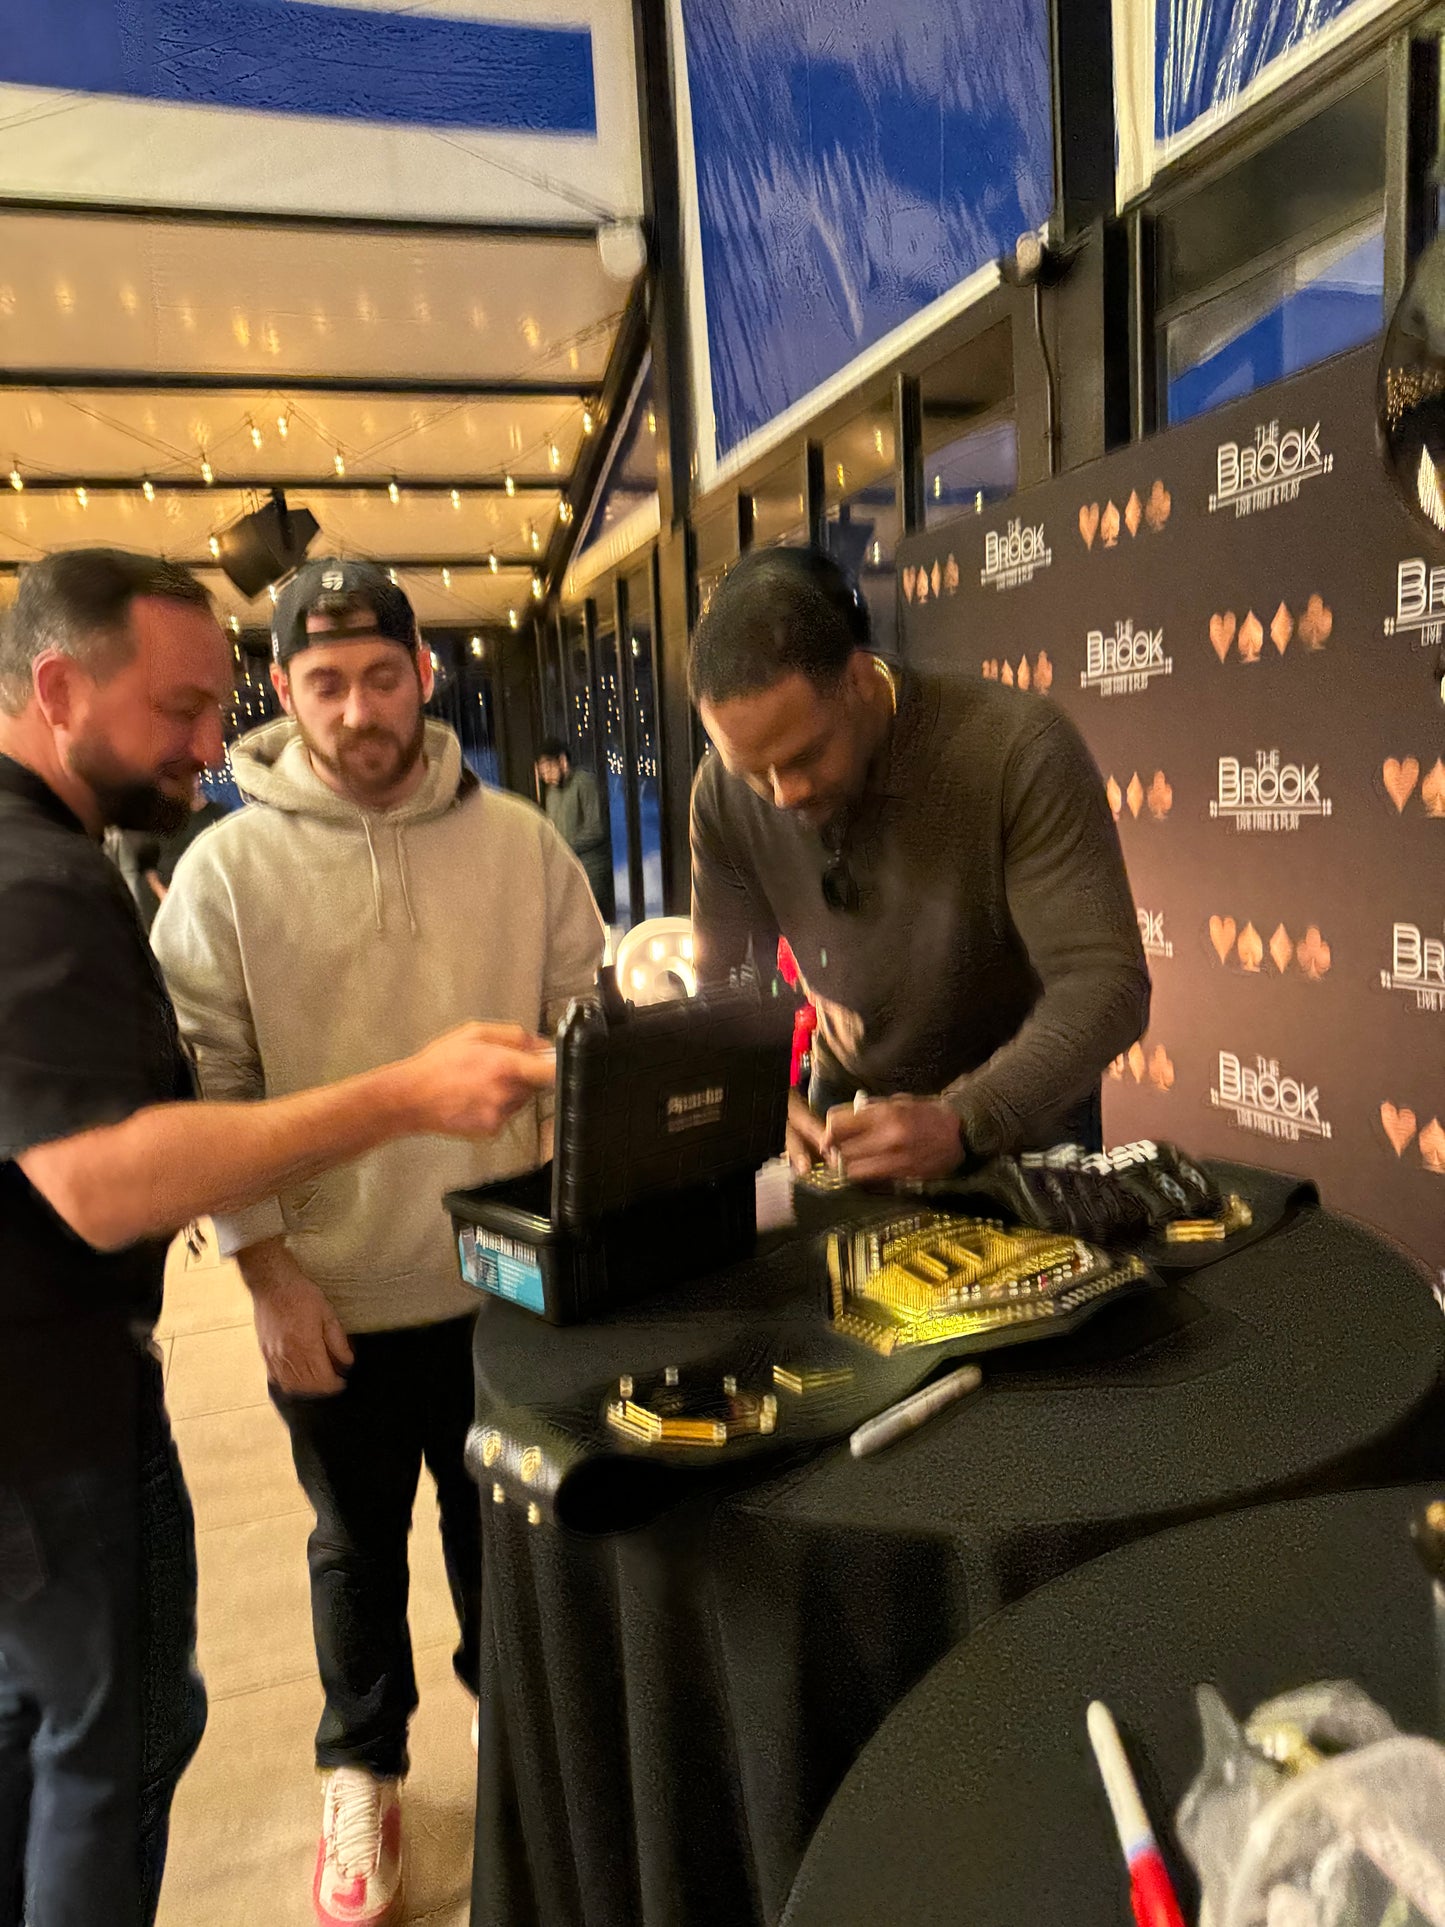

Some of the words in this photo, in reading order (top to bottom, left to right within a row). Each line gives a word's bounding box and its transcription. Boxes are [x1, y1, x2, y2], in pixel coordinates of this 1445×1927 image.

[1255, 419, 1279, 448] THE
[1217, 421, 1321, 499] BROOK
[986, 523, 1045, 574] BROOK
[1087, 627, 1164, 678] BROOK
[1219, 756, 1320, 806] BROOK
[1256, 749, 1280, 772] THE
[1219, 1050, 1320, 1126] BROOK
